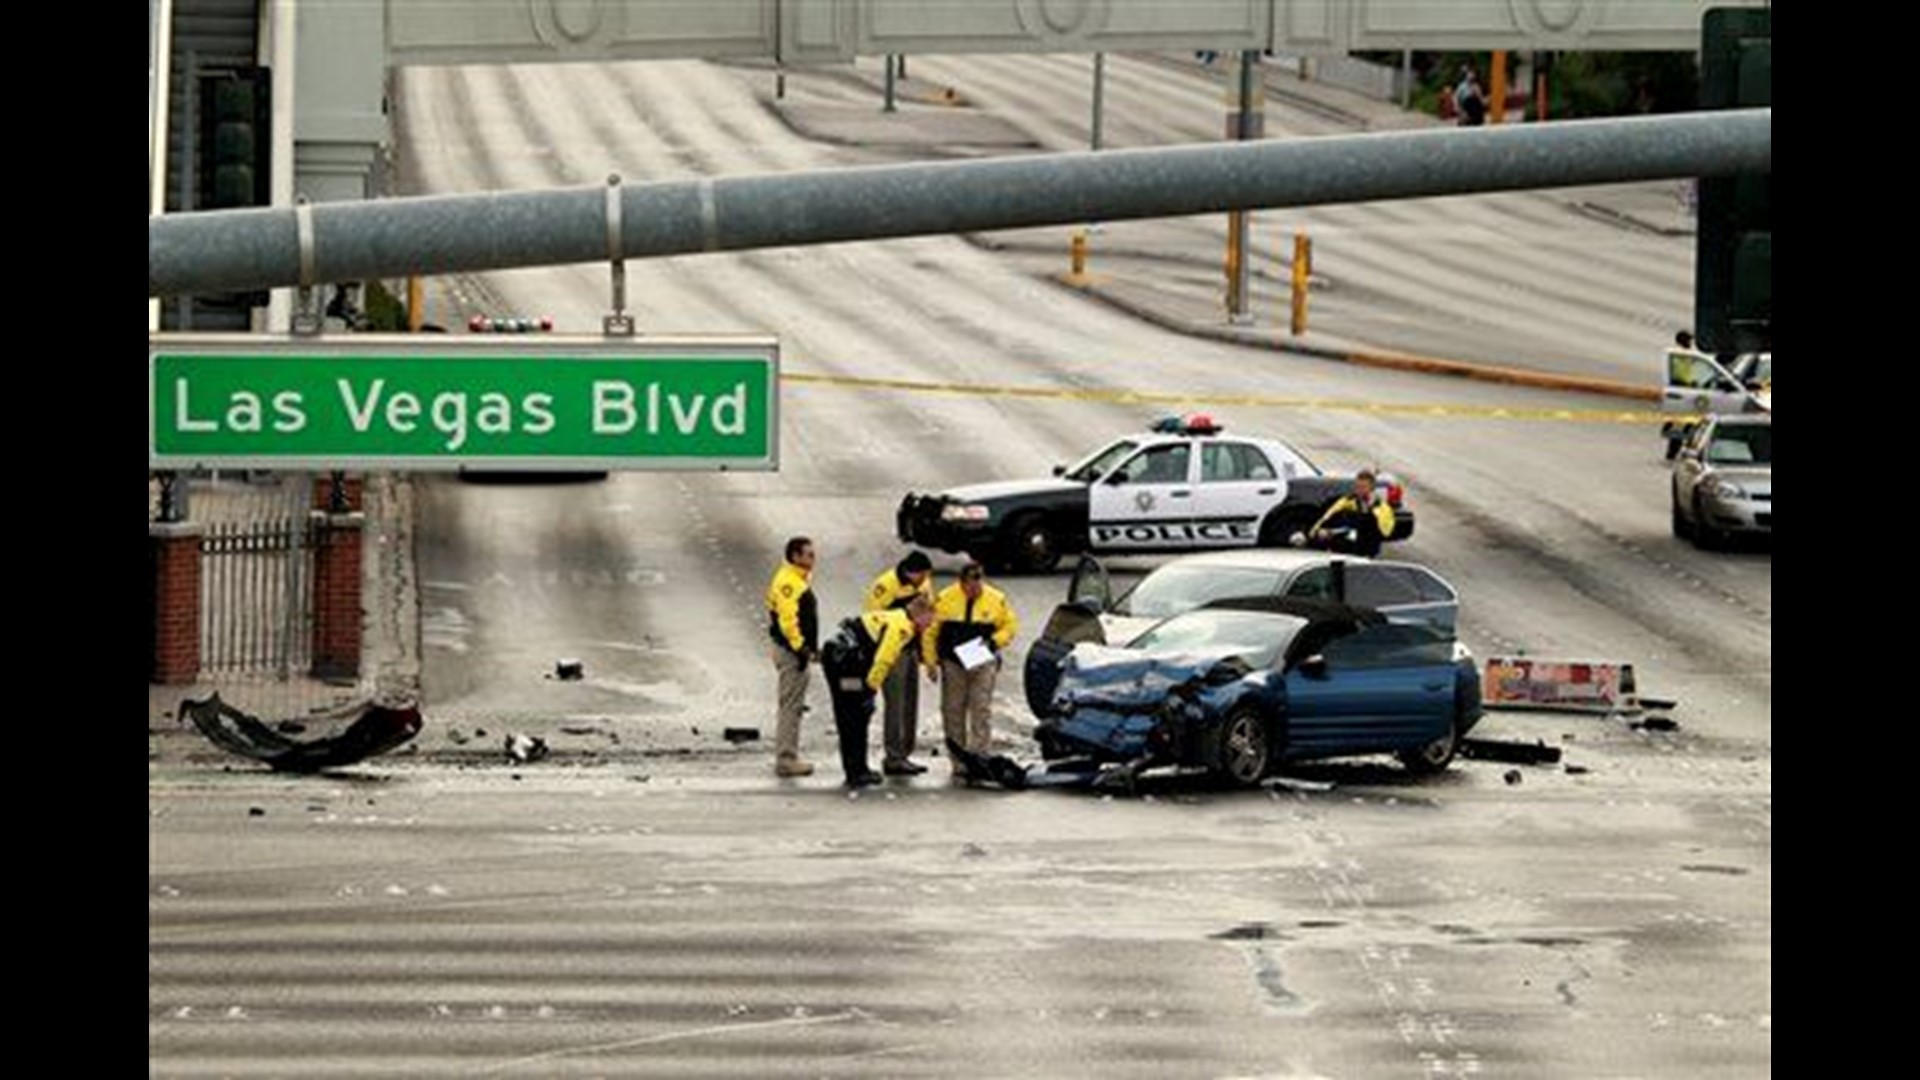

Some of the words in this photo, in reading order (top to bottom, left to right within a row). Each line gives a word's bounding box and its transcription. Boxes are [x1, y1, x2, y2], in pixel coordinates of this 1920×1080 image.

[176, 377, 306, 432] Las
[337, 379, 555, 450] Vegas
[592, 380, 747, 434] Blvd
[1095, 523, 1255, 543] POLICE
